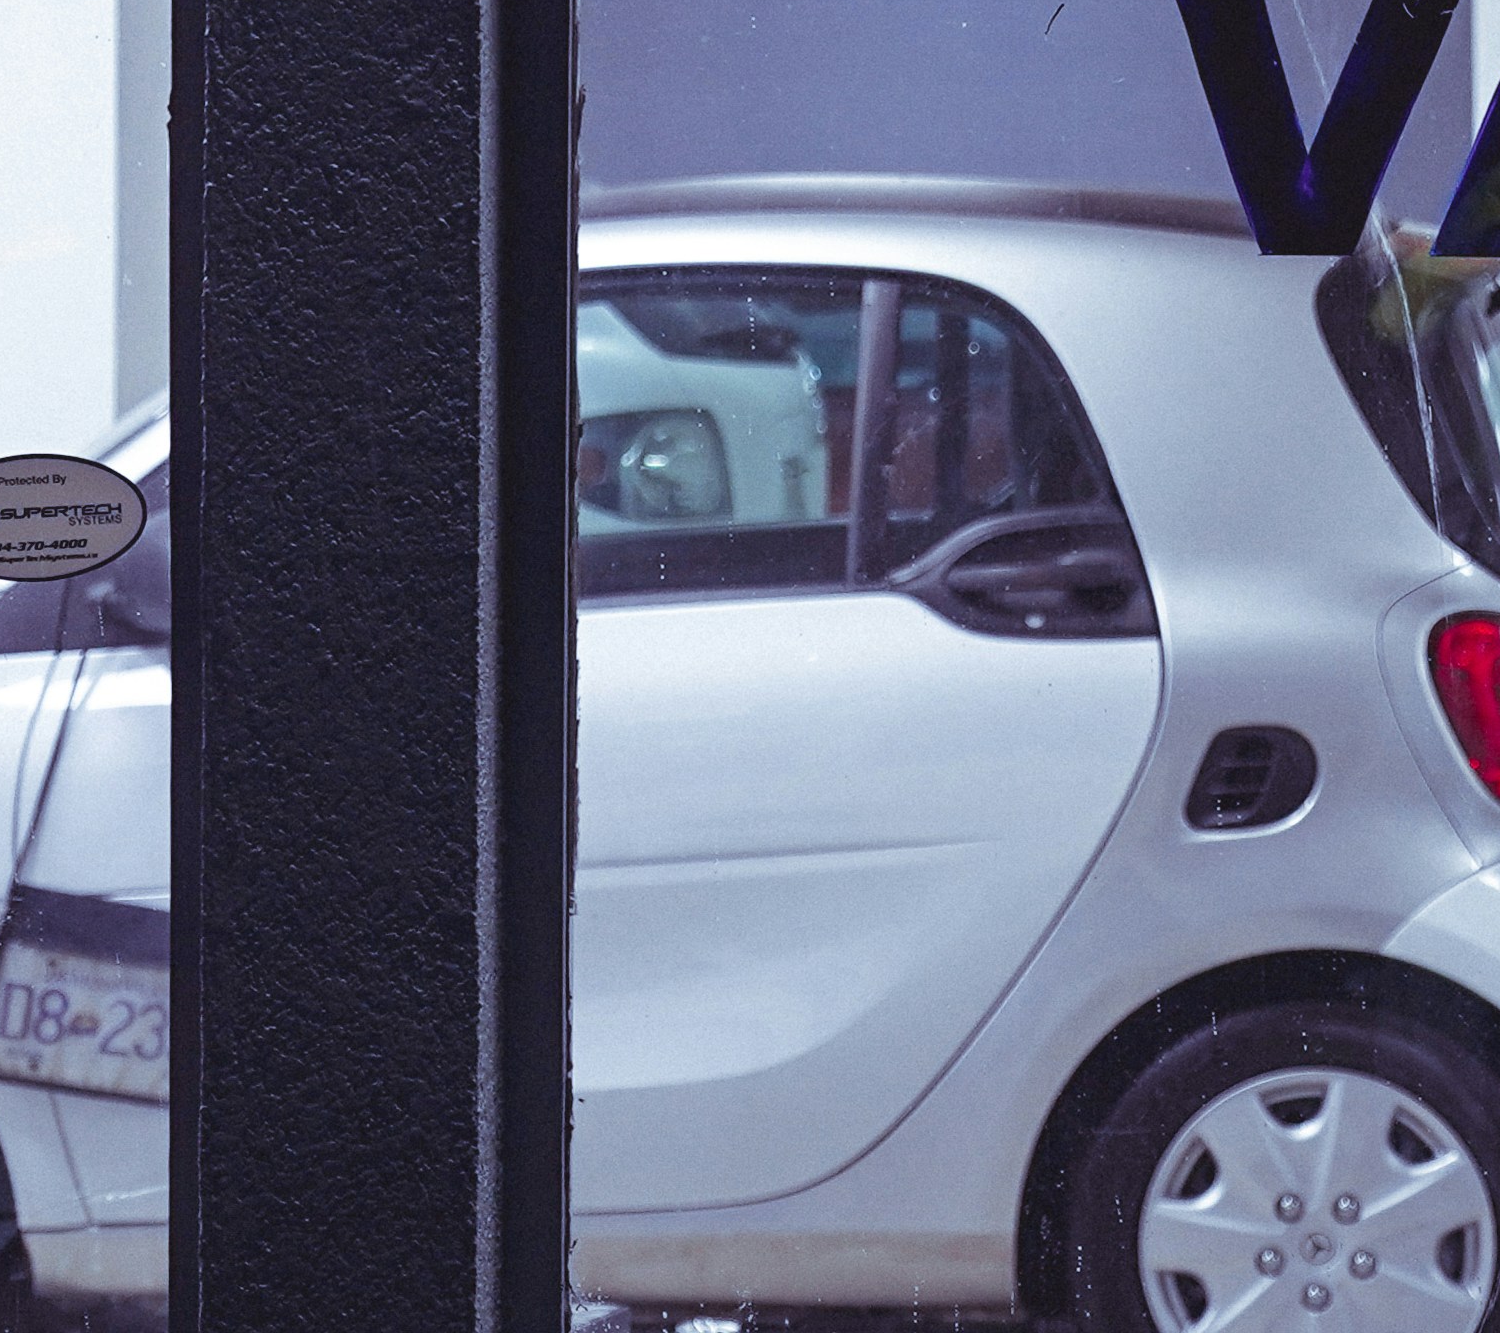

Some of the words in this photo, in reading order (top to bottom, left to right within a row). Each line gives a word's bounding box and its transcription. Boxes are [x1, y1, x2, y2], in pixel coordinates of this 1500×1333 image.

[52, 474, 67, 485] By
[0, 502, 122, 520] SUPERTECH
[68, 514, 123, 527] SYSTEMS
